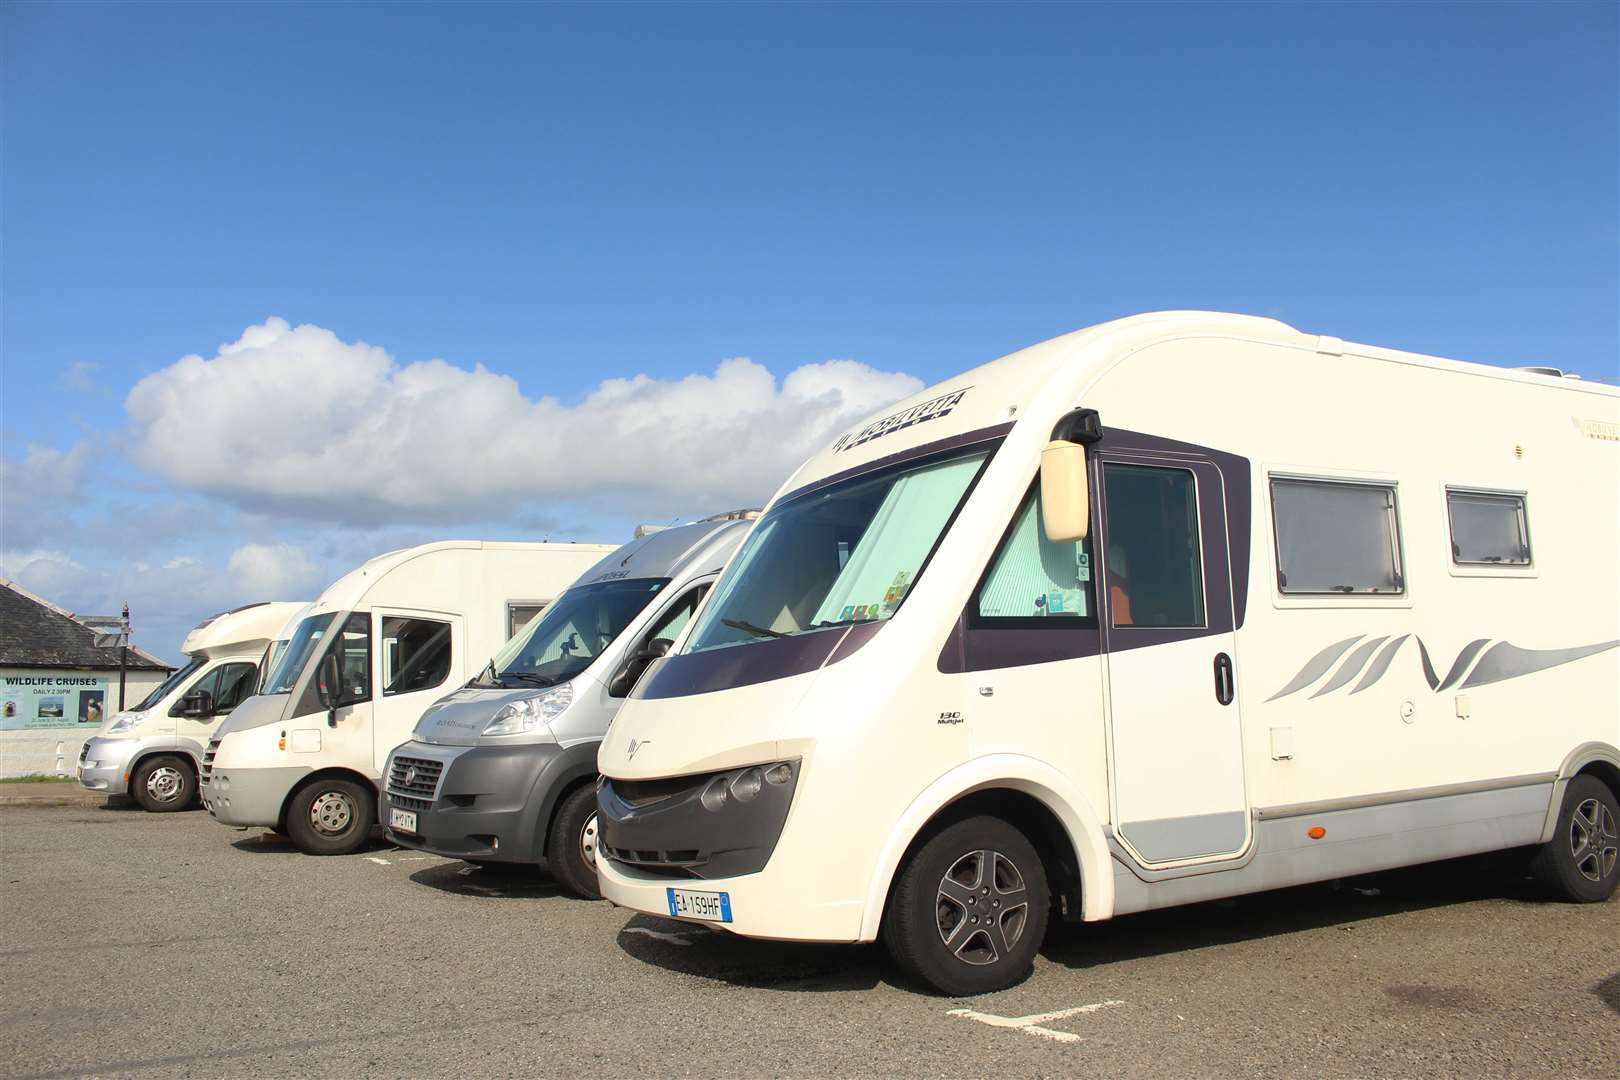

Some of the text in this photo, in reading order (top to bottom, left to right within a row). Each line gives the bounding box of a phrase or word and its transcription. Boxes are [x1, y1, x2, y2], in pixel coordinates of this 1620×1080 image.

[849, 391, 967, 442] MOBILVETTA
[6, 677, 97, 686] WILDLIFE CRUISES
[940, 711, 960, 719] 130
